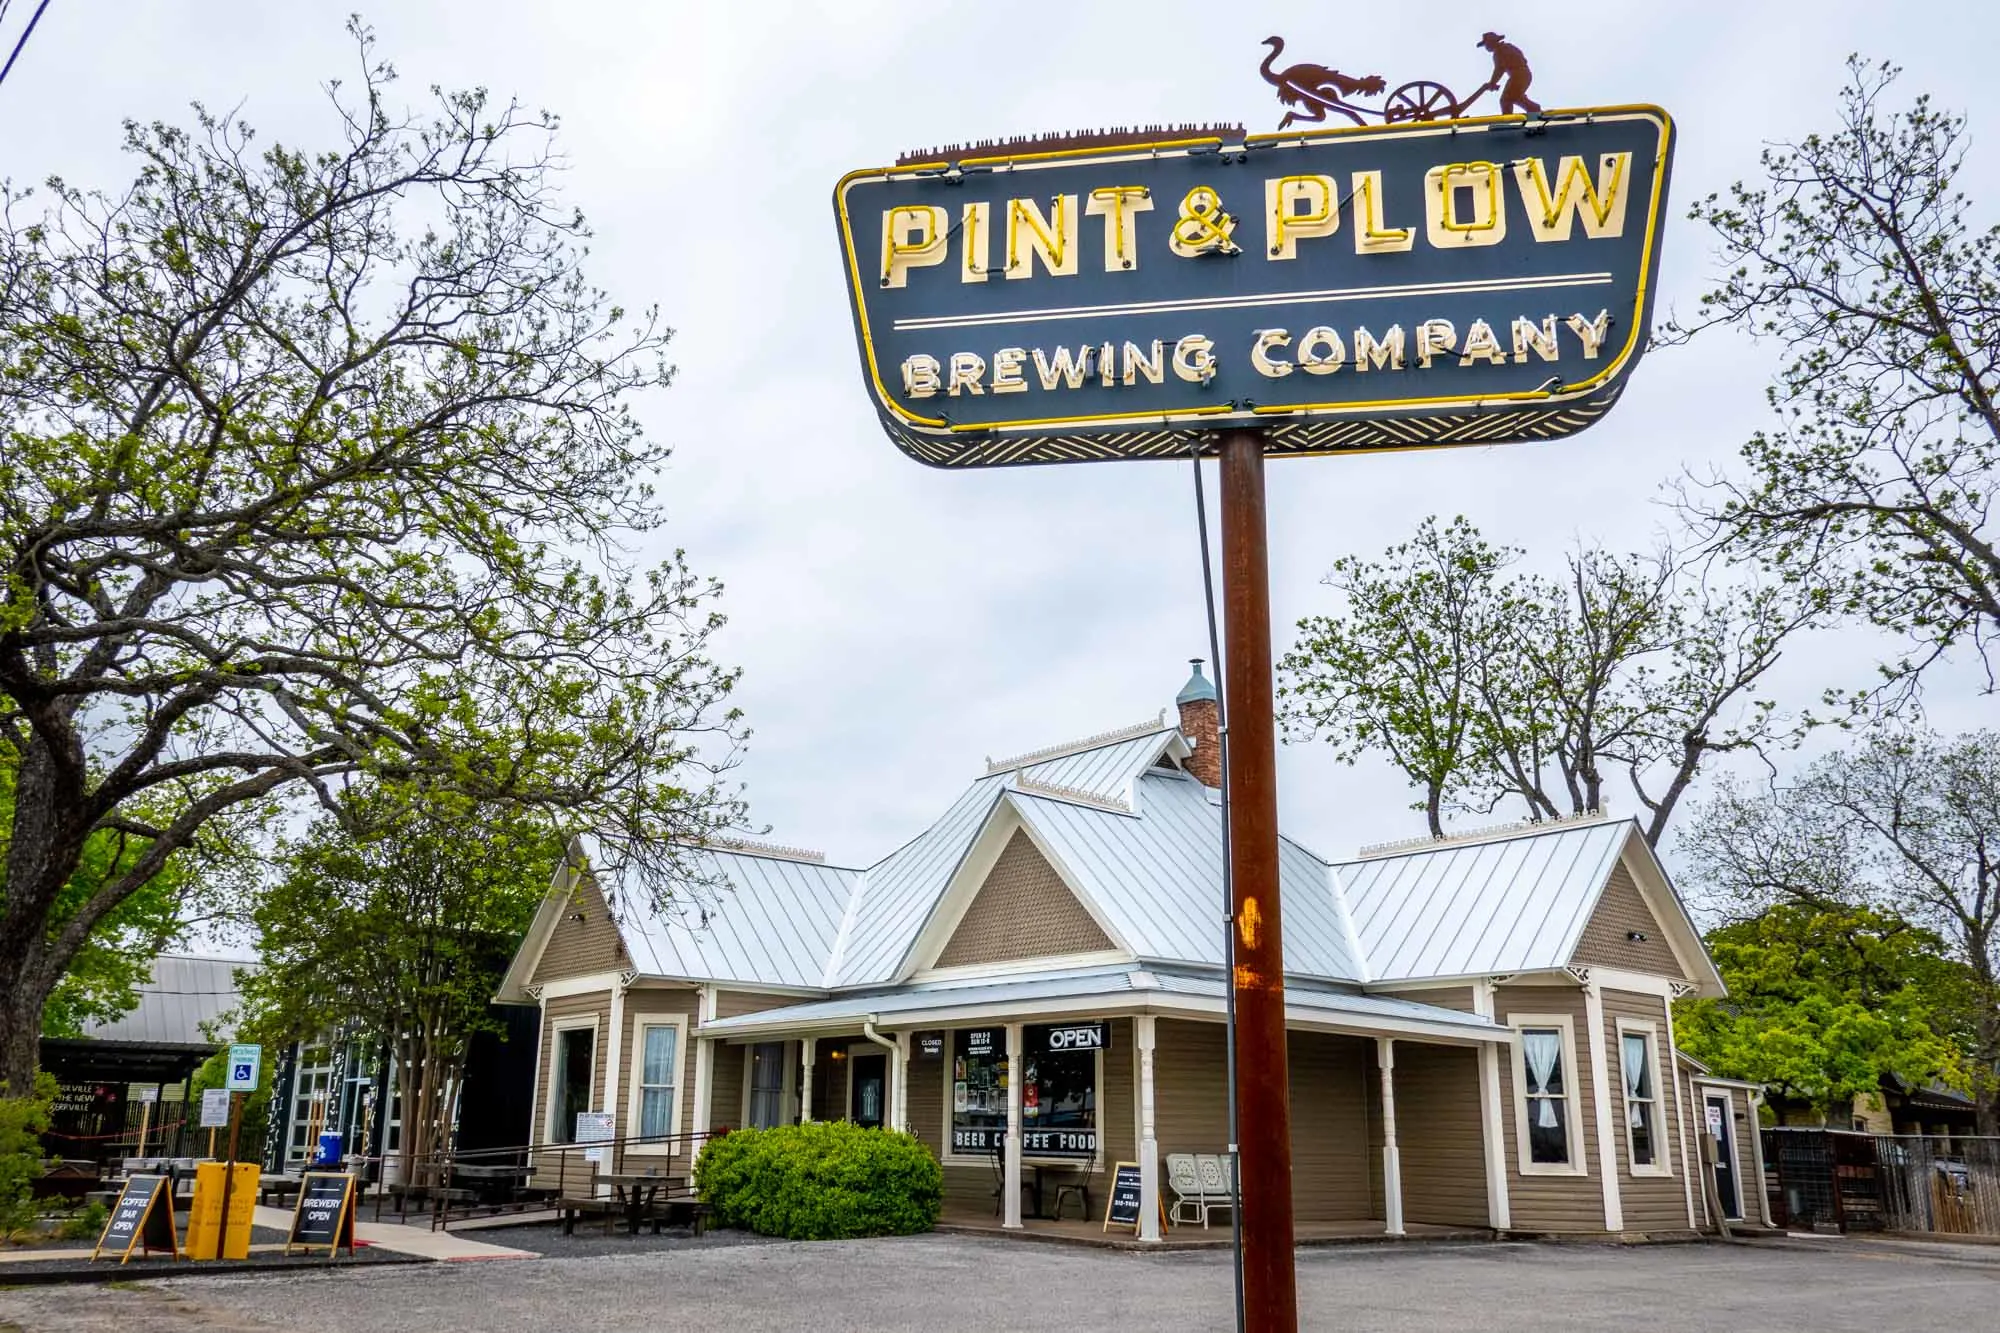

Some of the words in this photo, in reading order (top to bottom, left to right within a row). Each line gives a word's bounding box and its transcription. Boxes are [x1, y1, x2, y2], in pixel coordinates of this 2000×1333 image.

[880, 185, 1154, 289] PINT
[1168, 185, 1244, 259] &
[1265, 151, 1632, 261] PLOW
[902, 334, 1217, 398] BREWING
[1251, 308, 1614, 378] COMPANY
[921, 1039, 942, 1047] CLOSED
[1049, 1027, 1101, 1049] OPEN
[74, 1093, 95, 1103] NEW
[956, 1132, 986, 1147] BEER
[994, 1132, 1049, 1148] CFEE
[1059, 1134, 1096, 1150] FOOD
[121, 1197, 150, 1207] COFFEE
[303, 1198, 342, 1208] BREWERY
[121, 1209, 137, 1219] BAR
[308, 1211, 331, 1221] OPEN
[113, 1221, 135, 1231] OPEN
